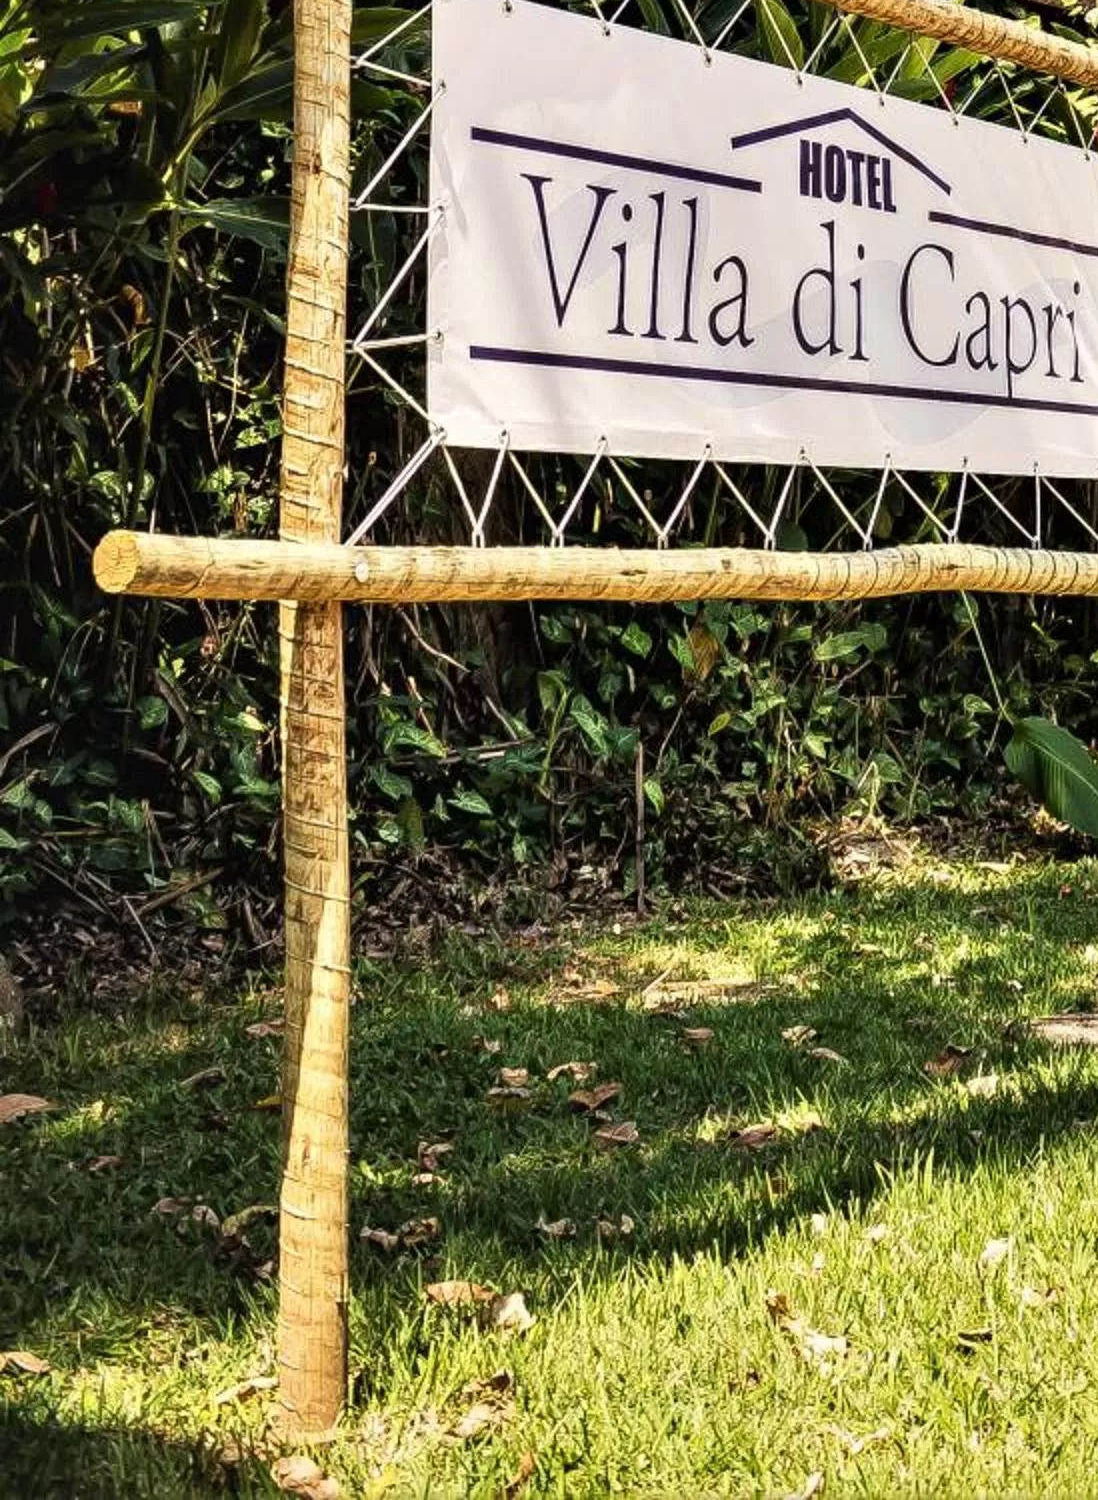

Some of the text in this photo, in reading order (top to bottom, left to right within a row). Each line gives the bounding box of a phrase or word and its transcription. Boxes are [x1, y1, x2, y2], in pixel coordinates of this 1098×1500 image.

[800, 139, 897, 213] HOTEL
[520, 173, 1086, 399] Villa di Capri
